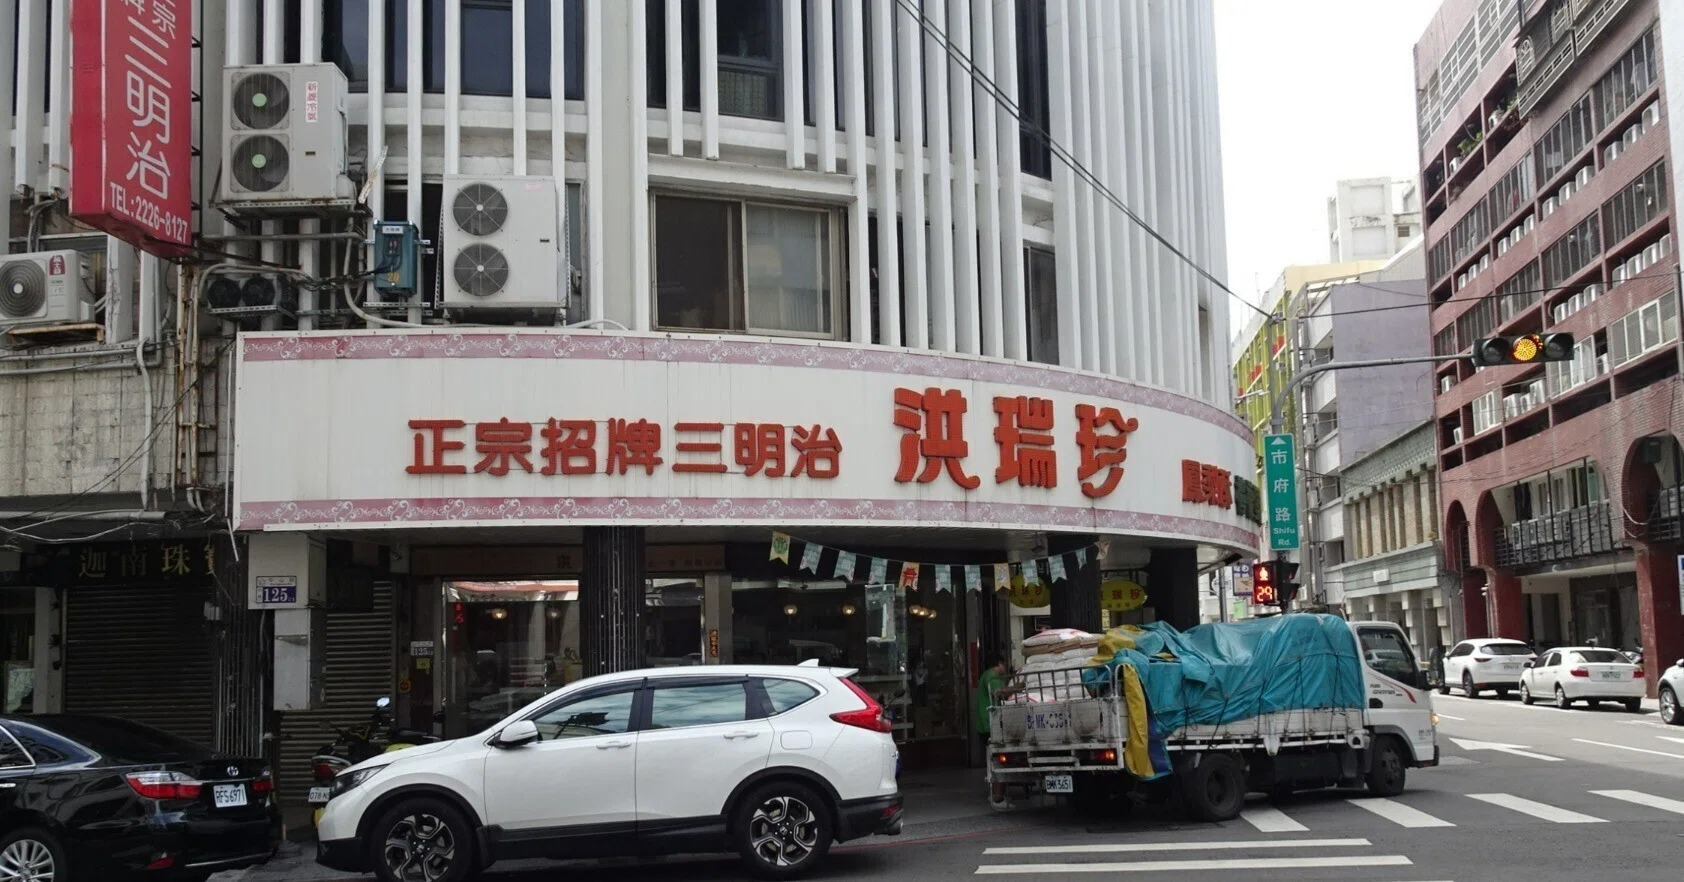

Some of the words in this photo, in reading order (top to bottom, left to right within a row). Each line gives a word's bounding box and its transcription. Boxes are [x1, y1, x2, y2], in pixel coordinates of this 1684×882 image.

[152, 0, 176, 40] 宗
[125, 16, 172, 200] 三明治
[405, 417, 843, 478] 正宗招牌三明治
[893, 387, 1138, 498] 洪瑞珍
[1271, 449, 1291, 521] 市府路
[1273, 527, 1295, 535] Shifu
[263, 587, 288, 602] 125
[1100, 588, 1144, 600] 瑞珍
